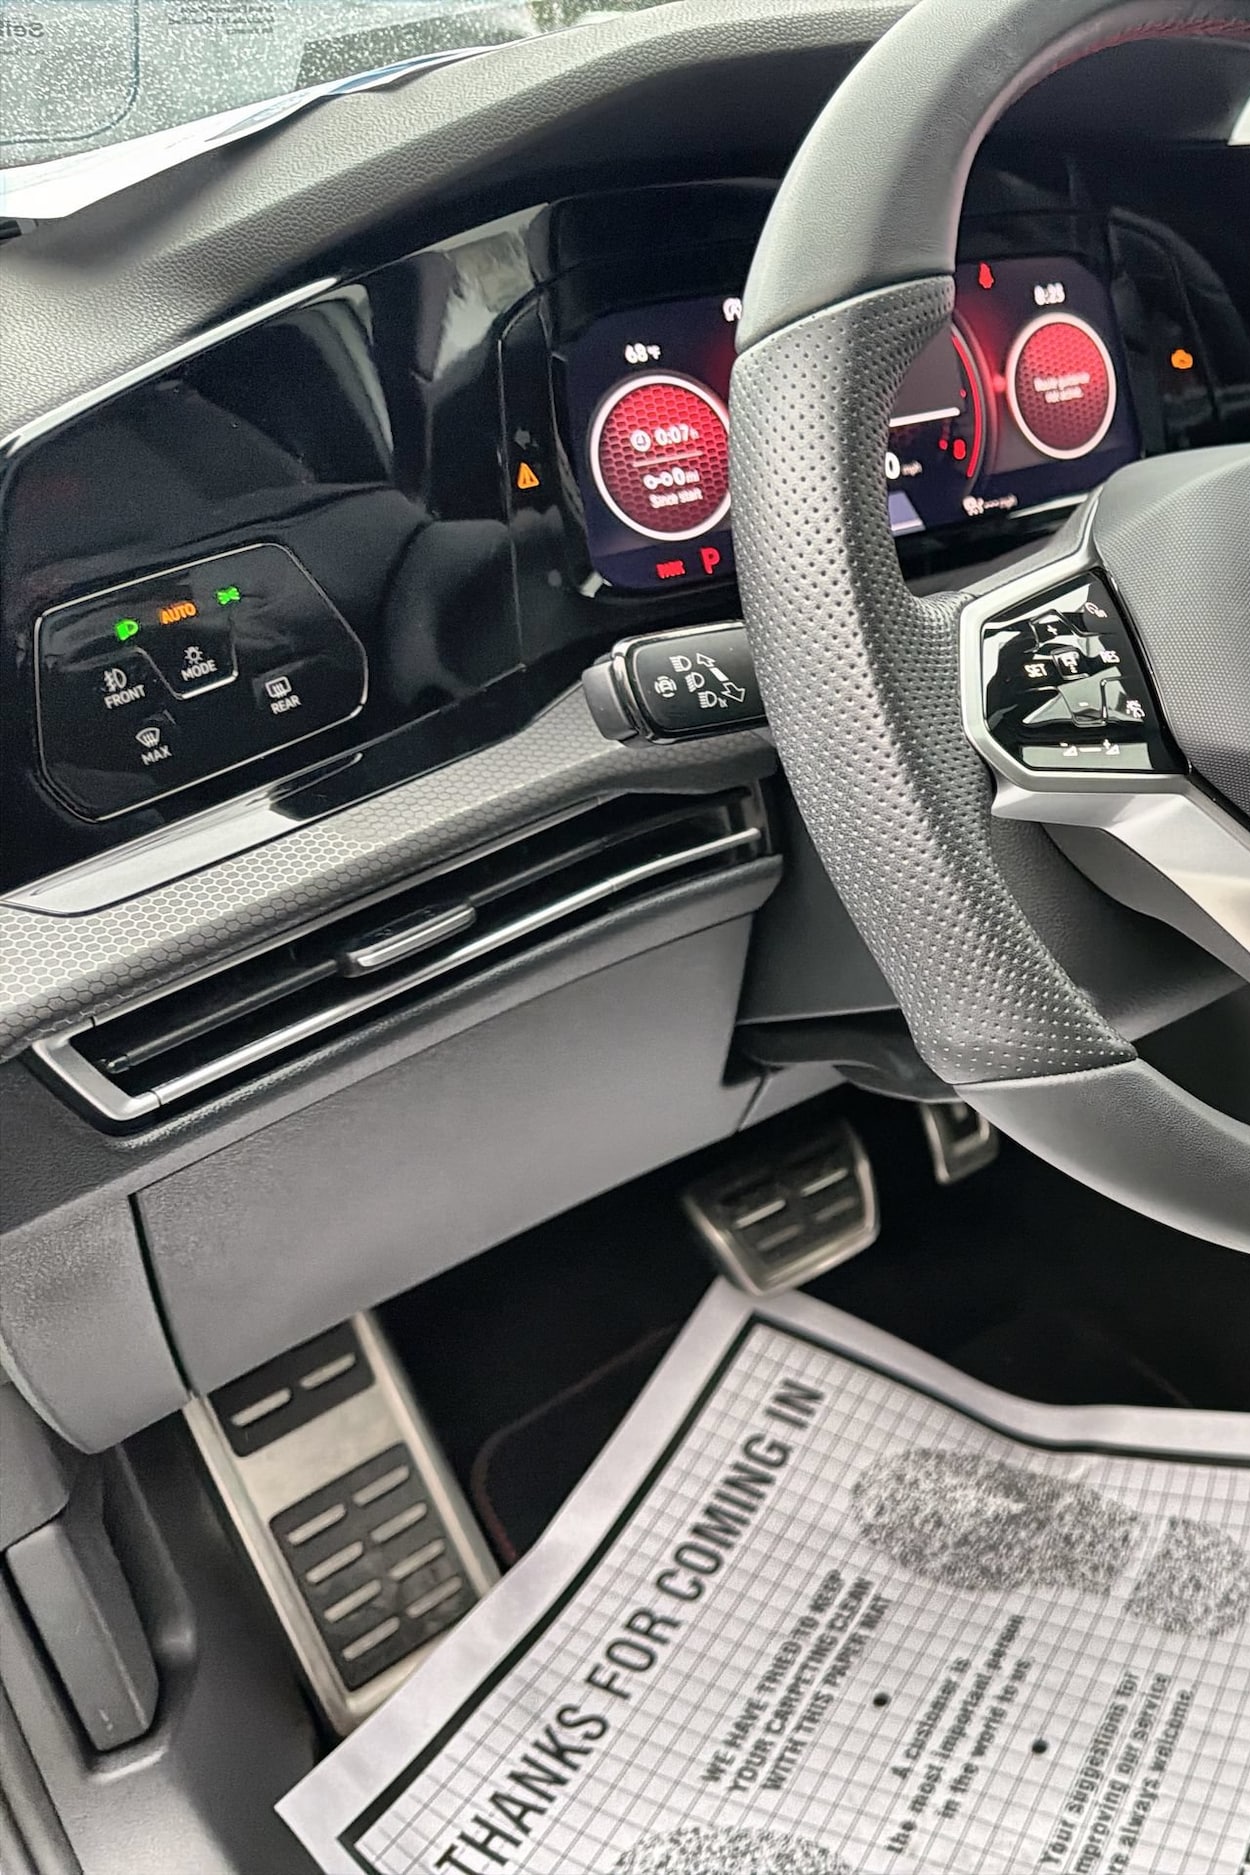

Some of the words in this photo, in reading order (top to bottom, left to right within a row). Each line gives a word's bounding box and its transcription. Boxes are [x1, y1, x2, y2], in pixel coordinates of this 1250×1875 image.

[160, 602, 197, 625] AUTO
[701, 547, 721, 575] P
[104, 684, 146, 709] FRONT
[181, 659, 218, 681] MODE
[271, 694, 302, 715] REAR
[1024, 663, 1048, 679] SET
[141, 745, 172, 765] MAX
[434, 1704, 609, 1875] THANKS
[584, 1607, 682, 1701] FOR
[655, 1432, 794, 1602] COMING
[764, 1377, 824, 1431] IN
[701, 1749, 736, 1782] WE
[722, 1698, 769, 1749] HAVE
[754, 1641, 802, 1694] TRIED
[790, 1615, 820, 1641] TO
[808, 1569, 845, 1614] KEEP
[727, 1738, 774, 1792] YOUR
[764, 1632, 839, 1735] CARPETING
[826, 1576, 874, 1632] CLEAN
[761, 1736, 807, 1790] WITH
[793, 1690, 834, 1734] THIS
[822, 1632, 870, 1688] PAPER
[858, 1593, 892, 1630] MAT
[884, 1821, 918, 1854] the
[908, 1763, 944, 1814] most
[931, 1672, 992, 1760] important
[982, 1615, 1026, 1671] person
[890, 1765, 913, 1780] A
[903, 1678, 959, 1761] customer
[949, 1657, 973, 1674] is
[934, 1800, 961, 1819] in
[949, 1762, 979, 1794] the
[970, 1706, 1008, 1757] world
[994, 1685, 1019, 1703] to
[1038, 1819, 1077, 1865] Your
[1066, 1702, 1129, 1814] suggestions
[1115, 1671, 1141, 1698] for
[1068, 1778, 1130, 1875] mproving
[1116, 1741, 1141, 1776] our
[1129, 1672, 1171, 1743] service
[1118, 1776, 1160, 1849] always
